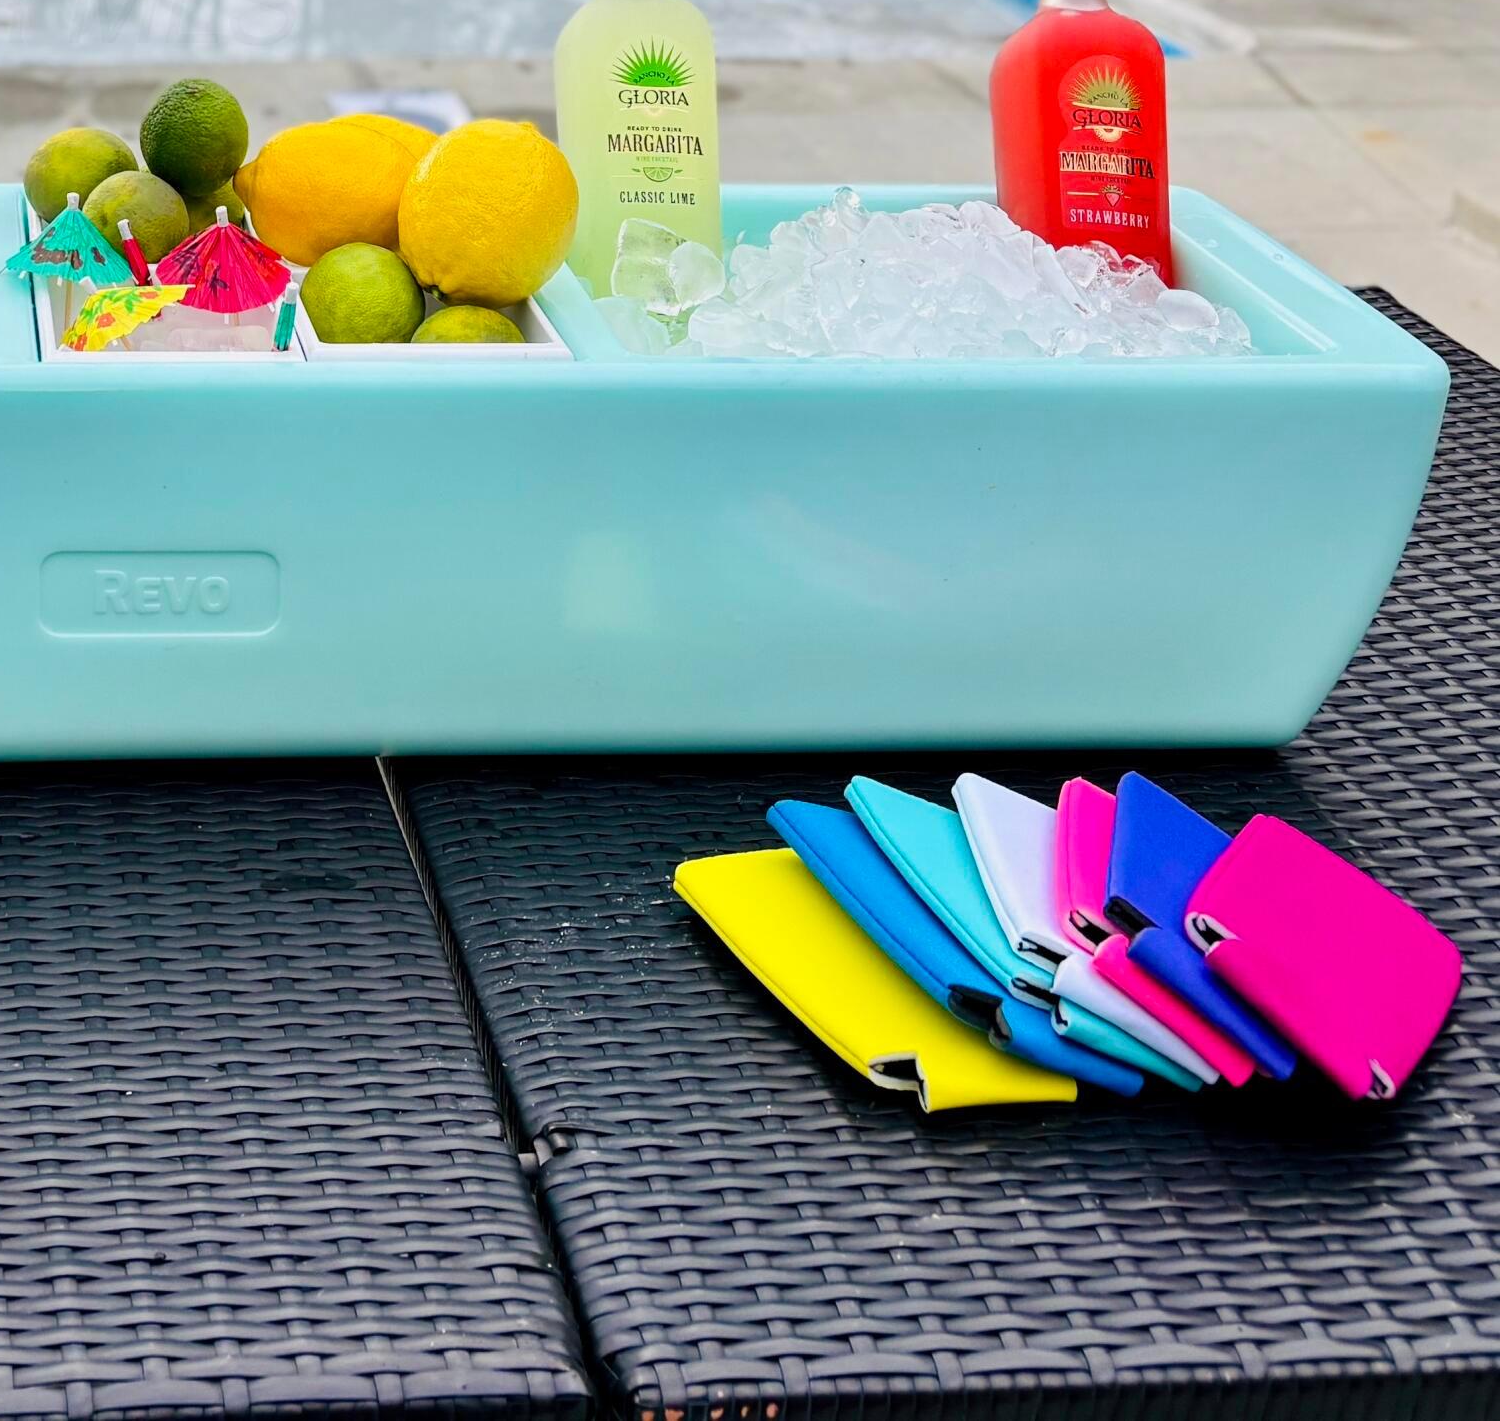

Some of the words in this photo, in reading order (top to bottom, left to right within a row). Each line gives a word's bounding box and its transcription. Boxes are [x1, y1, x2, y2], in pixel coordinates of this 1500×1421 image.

[619, 90, 689, 108] GLORIA
[1073, 109, 1141, 128] GLORIA
[608, 133, 704, 155] MARGARITA
[1062, 153, 1156, 179] MARGARITA
[619, 191, 665, 204] CLASSIC
[670, 192, 696, 205] LIME
[1070, 208, 1150, 229] STRAWBERRY
[93, 569, 231, 615] REVO
